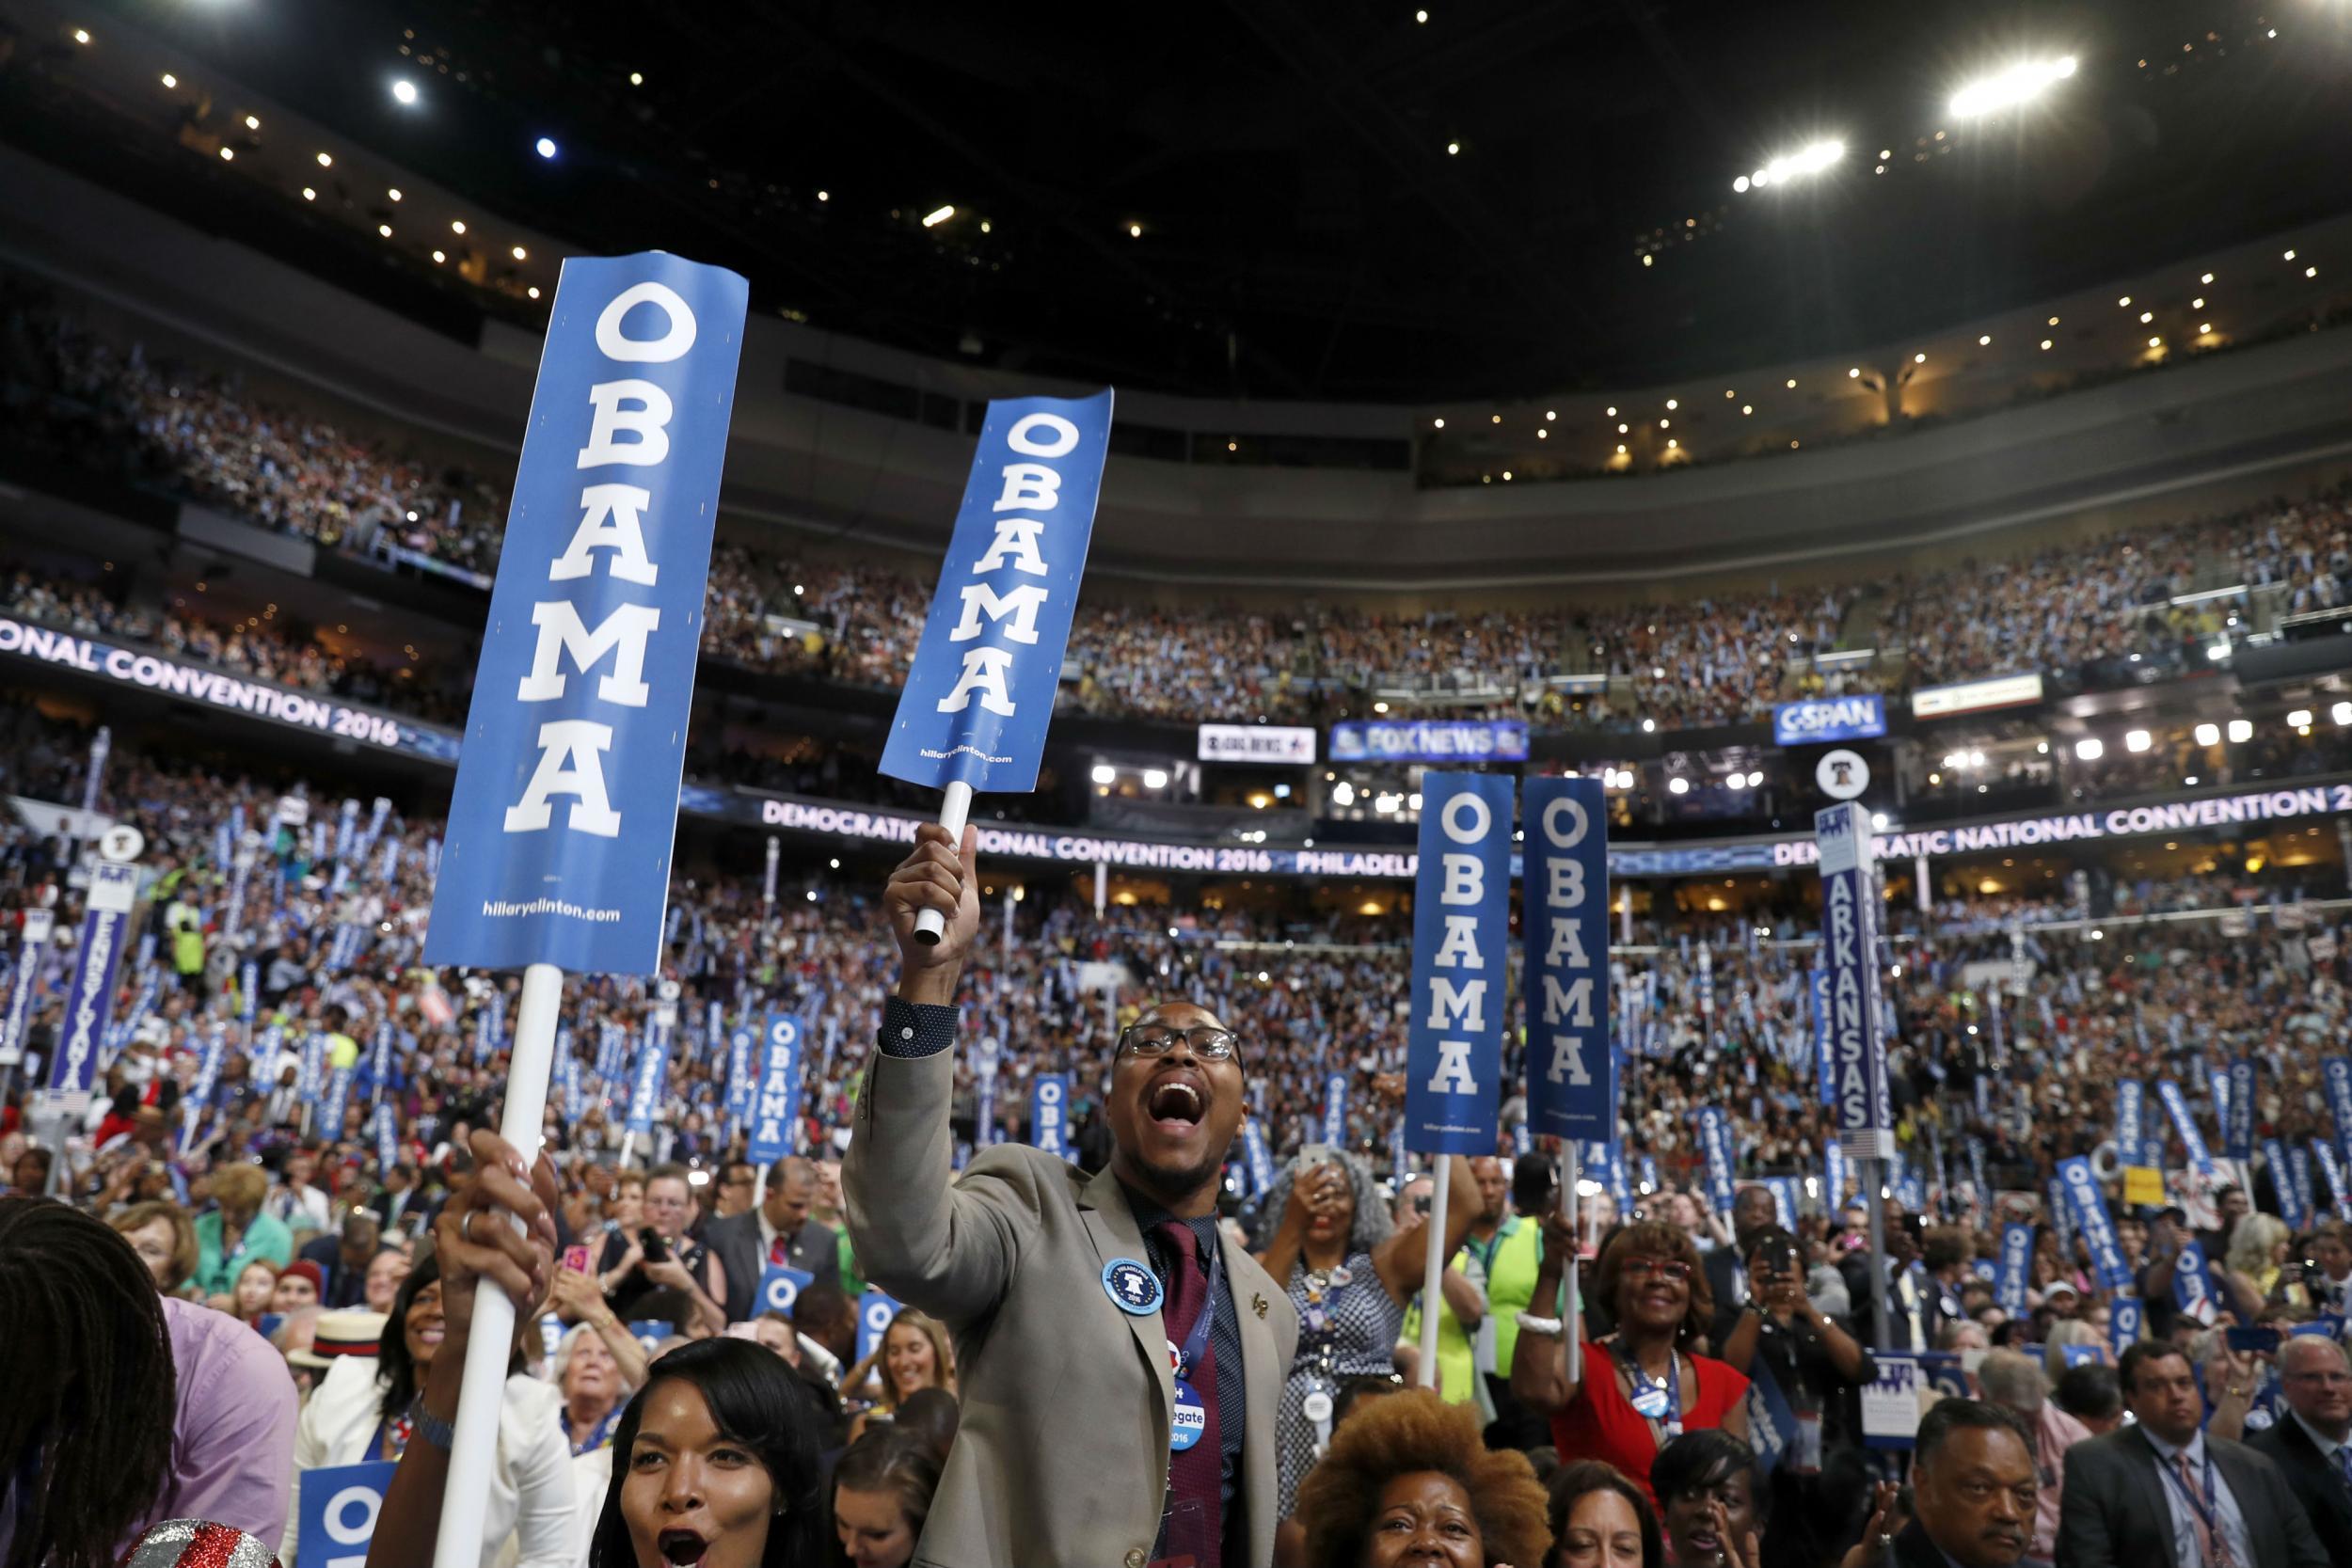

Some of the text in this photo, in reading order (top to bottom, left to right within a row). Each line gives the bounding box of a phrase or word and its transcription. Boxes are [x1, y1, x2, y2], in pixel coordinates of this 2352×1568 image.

[503, 281, 697, 838] OBAMA
[936, 412, 1080, 718] OBAMA
[105, 649, 332, 731] CONVENTION
[333, 707, 399, 748] 2016
[1780, 699, 1876, 733] C-SPAN
[920, 743, 1013, 764] hillaryclinton.com
[1367, 727, 1416, 753] FOX
[1420, 727, 1494, 754] NEWS
[977, 829, 1053, 858] IONAL
[1055, 836, 1215, 870] CONVENTION
[1217, 848, 1272, 873] 2016
[1954, 813, 2105, 853] NATIONAL
[2106, 786, 2328, 835] CONVENTION
[483, 897, 621, 922] hillaryclinton.com
[1427, 792, 1491, 1095] OBAMA
[1542, 797, 1594, 1085] OBAMA
[1829, 874, 1867, 1128] ARKANSAS
[757, 1021, 795, 1144] OBAMA
[1039, 1083, 1061, 1155] OBA
[2066, 1164, 2121, 1270] OBAMA
[1117, 1265, 1149, 1280] PHILADELPHIA
[1128, 1293, 1141, 1303] 2016
